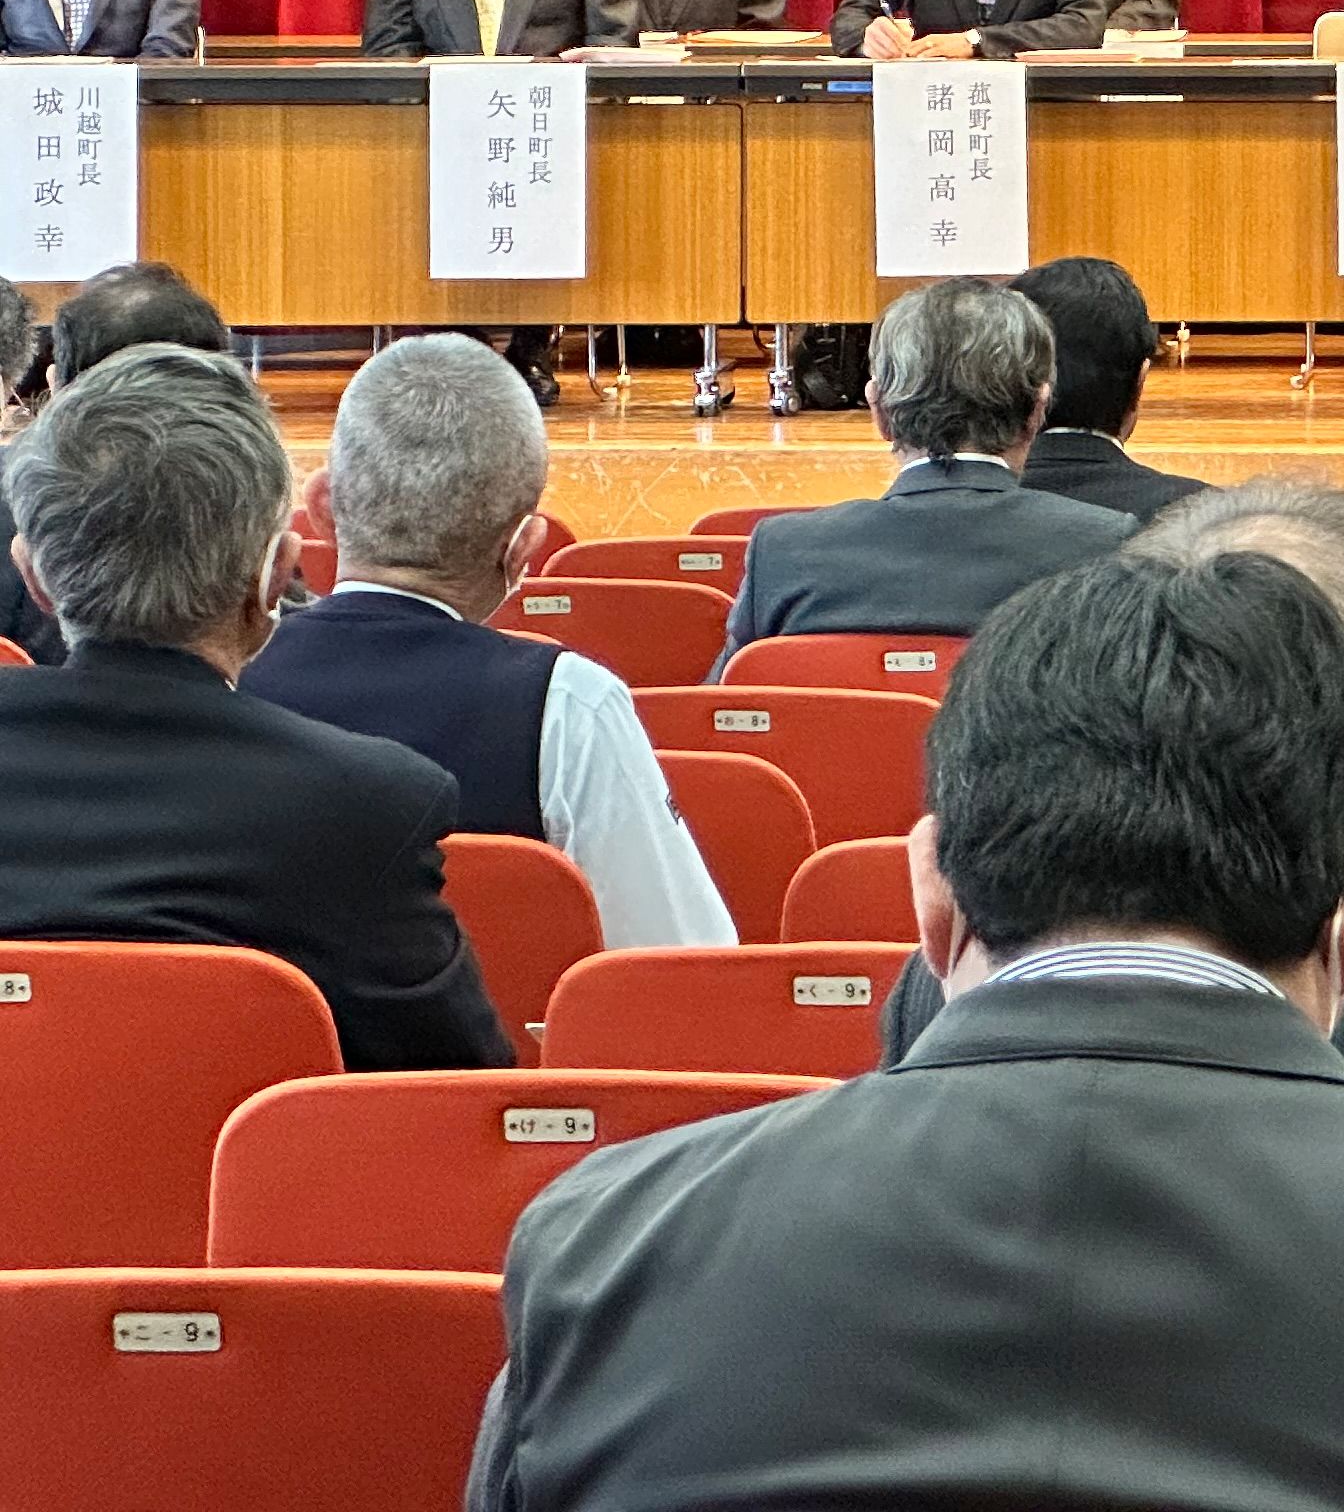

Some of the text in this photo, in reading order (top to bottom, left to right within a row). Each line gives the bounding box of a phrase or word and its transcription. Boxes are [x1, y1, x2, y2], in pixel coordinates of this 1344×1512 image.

[33, 87, 65, 252] 城田政幸
[75, 86, 103, 186] 川越町長
[487, 88, 517, 254] 矢野純男
[528, 85, 553, 184] 朝日町長
[967, 81, 993, 181] 菰野町長
